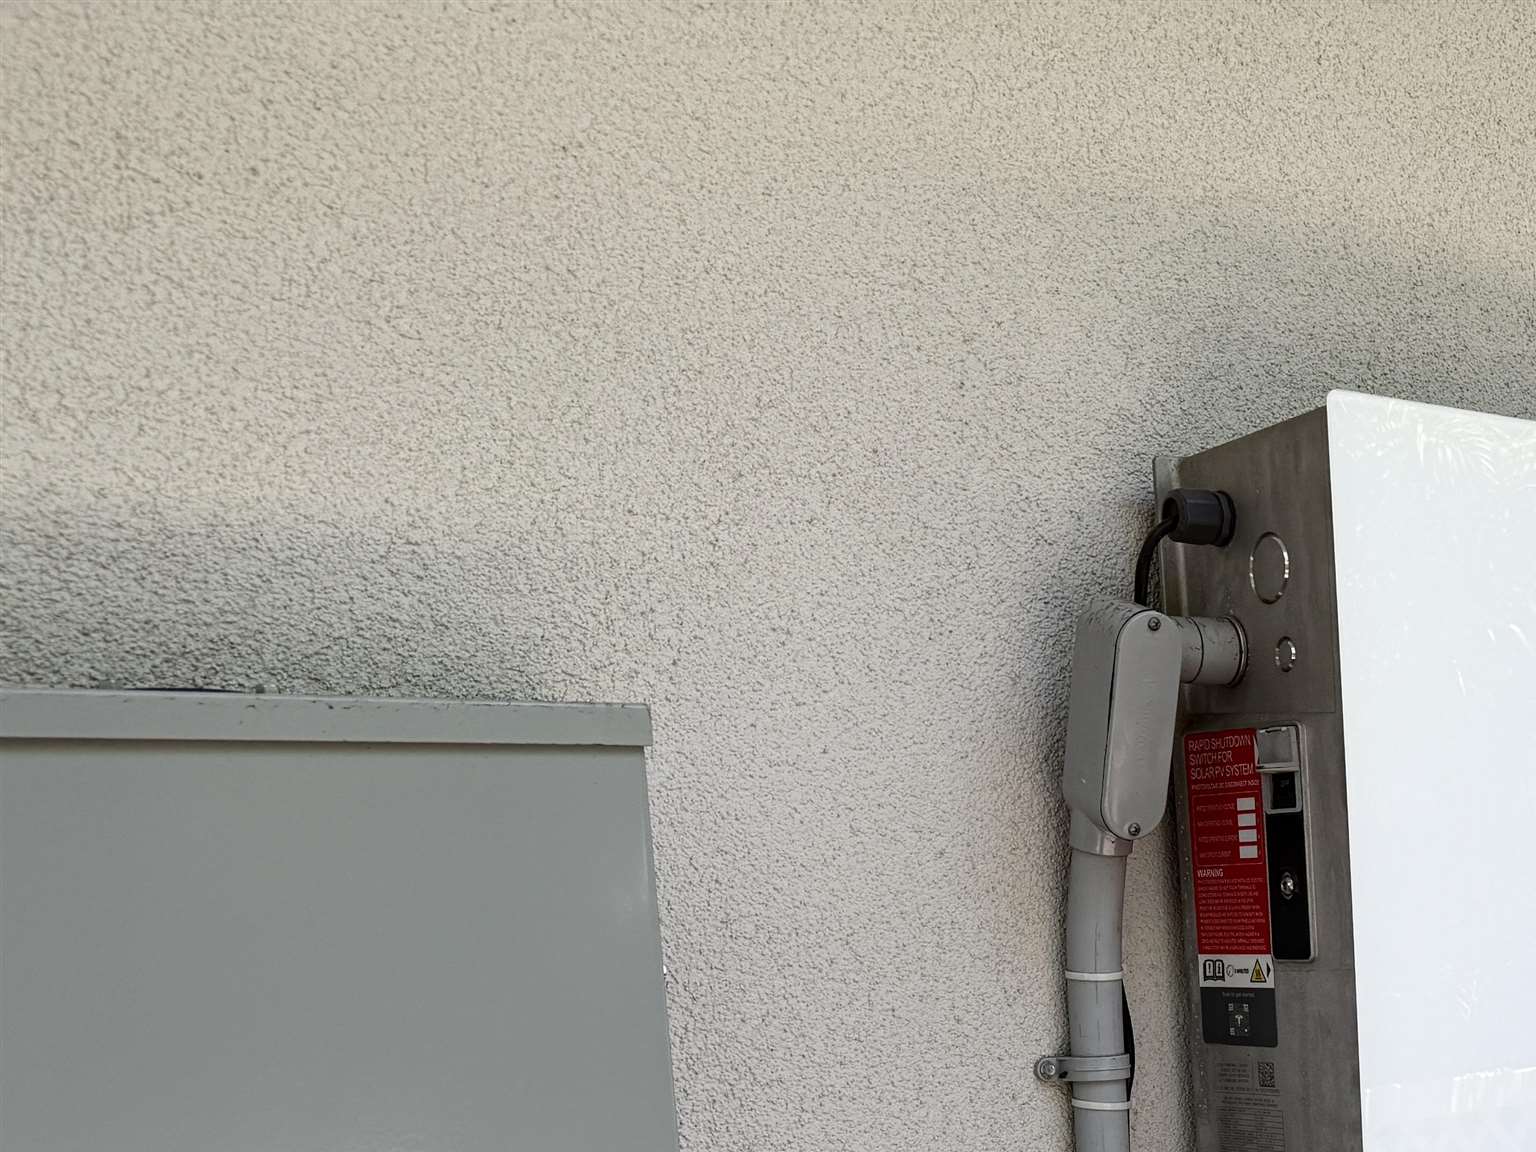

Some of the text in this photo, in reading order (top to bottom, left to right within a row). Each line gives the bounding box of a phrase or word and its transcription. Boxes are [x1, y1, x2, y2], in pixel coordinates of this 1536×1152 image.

[1188, 735, 1252, 752] RAPID SHUTDOWN
[1189, 750, 1233, 766] SWITCH FOR
[1191, 763, 1254, 780] SOLAR PV SYSTEM
[1197, 868, 1224, 878] WARNING
